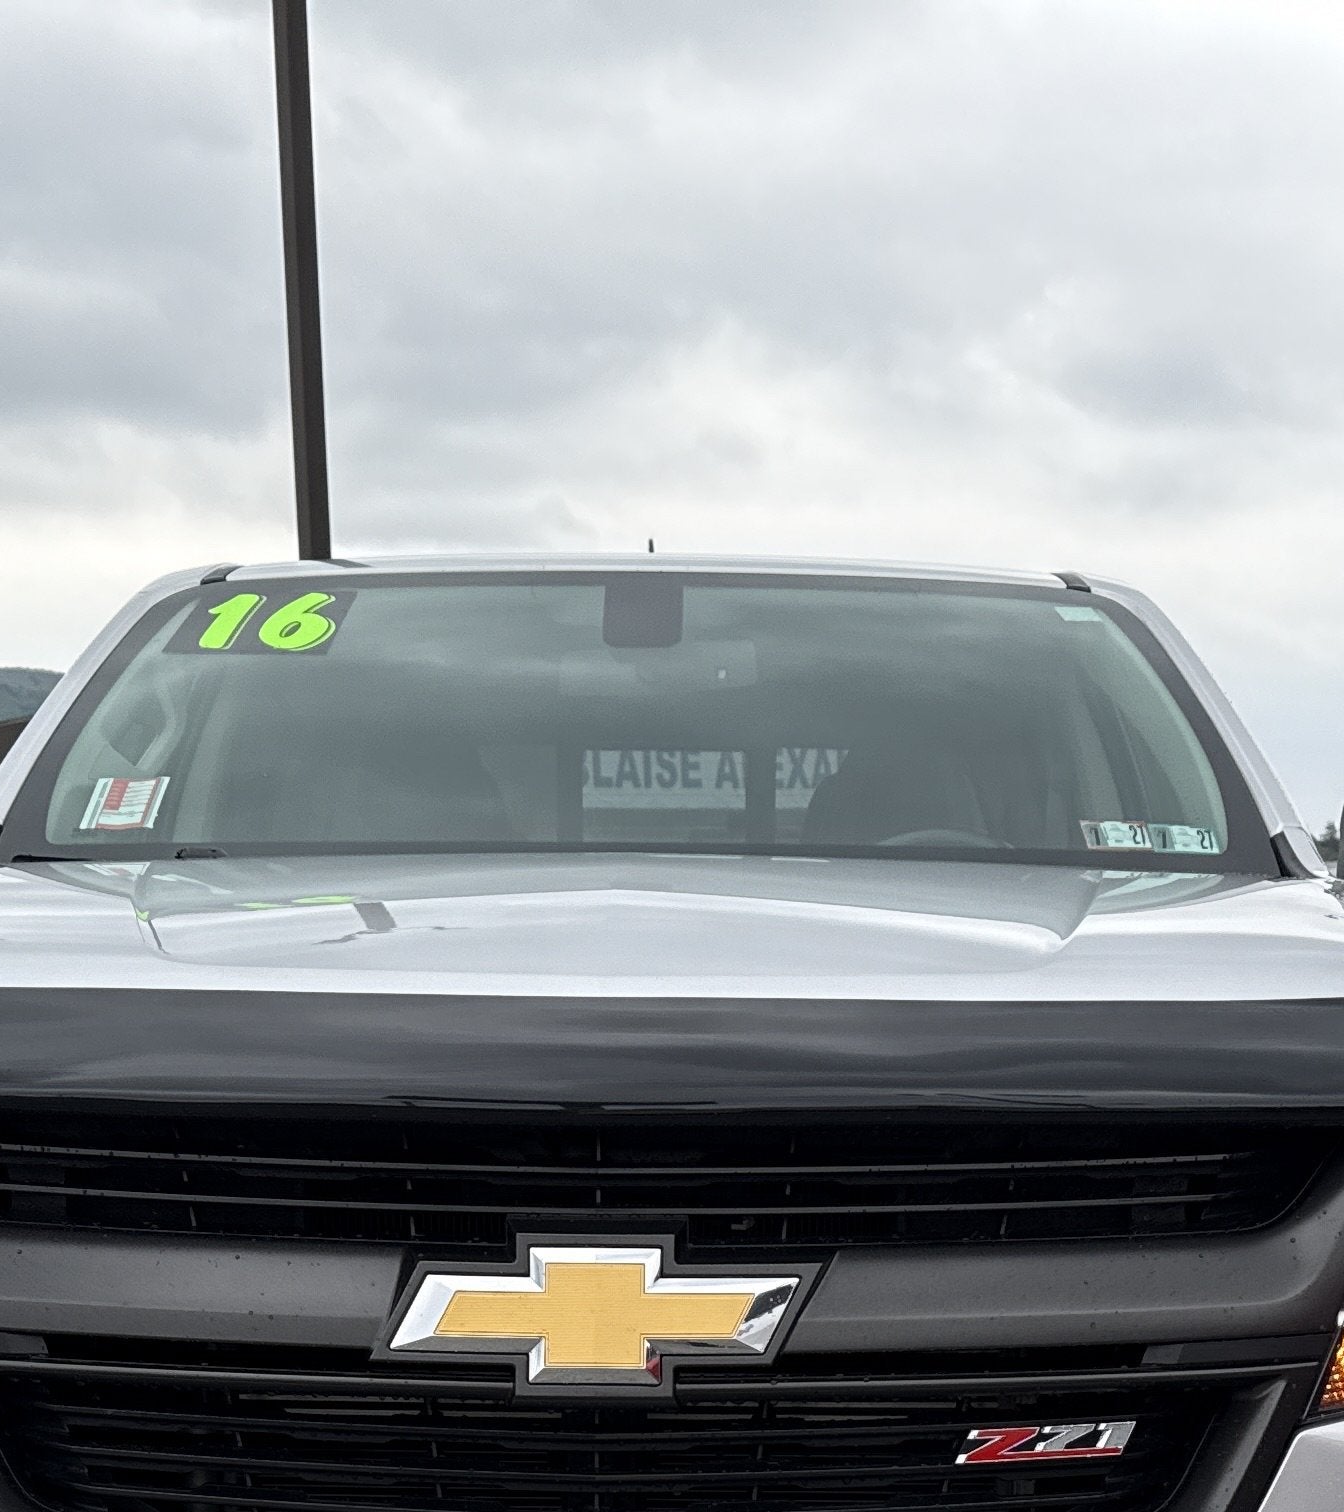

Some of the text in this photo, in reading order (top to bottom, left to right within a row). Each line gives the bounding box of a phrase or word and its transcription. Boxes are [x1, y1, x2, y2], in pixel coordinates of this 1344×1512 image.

[199, 592, 337, 651] 16
[582, 750, 703, 789] LAISE
[955, 1420, 1137, 1465] Z71
